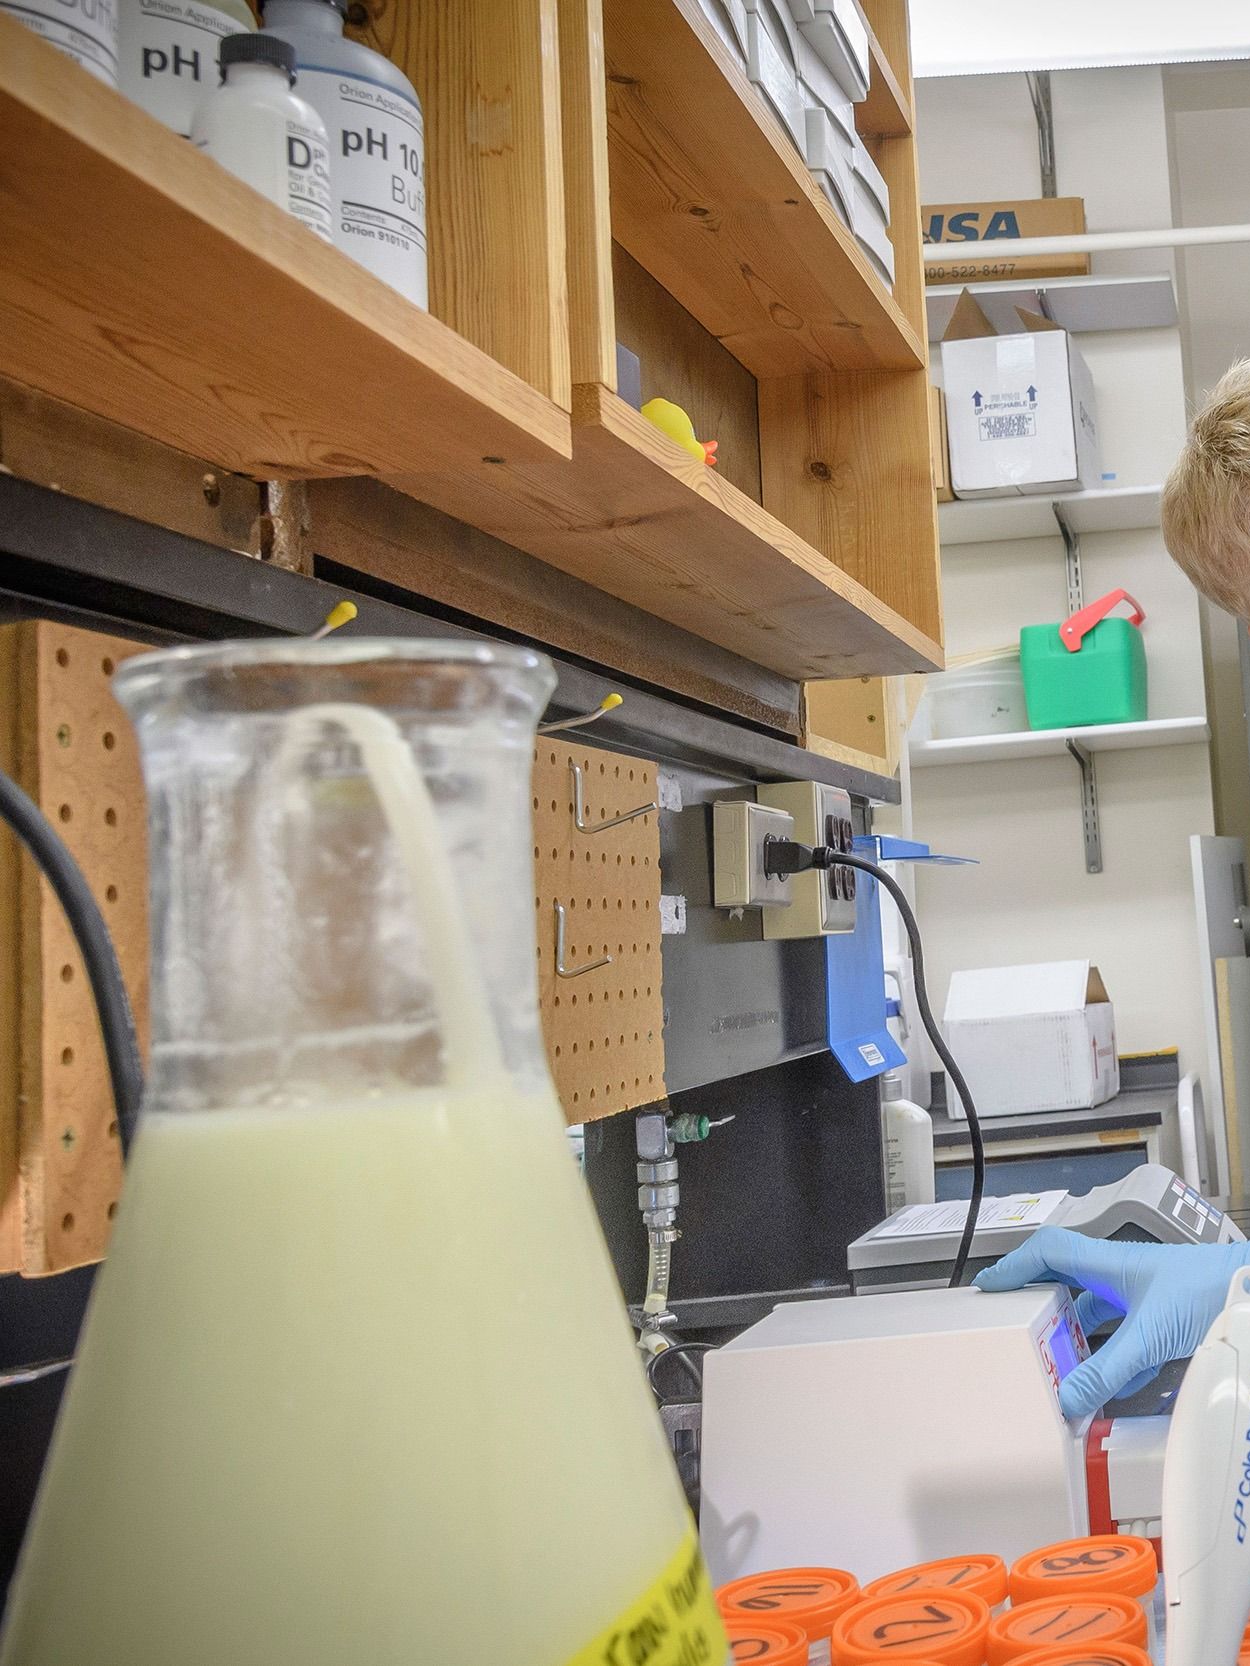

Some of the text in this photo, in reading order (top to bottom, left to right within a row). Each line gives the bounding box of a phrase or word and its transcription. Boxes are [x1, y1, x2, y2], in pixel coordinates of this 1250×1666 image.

[142, 44, 200, 81] pH
[287, 136, 312, 170] D
[341, 127, 425, 187] pH 10.
[341, 222, 376, 239] Orion
